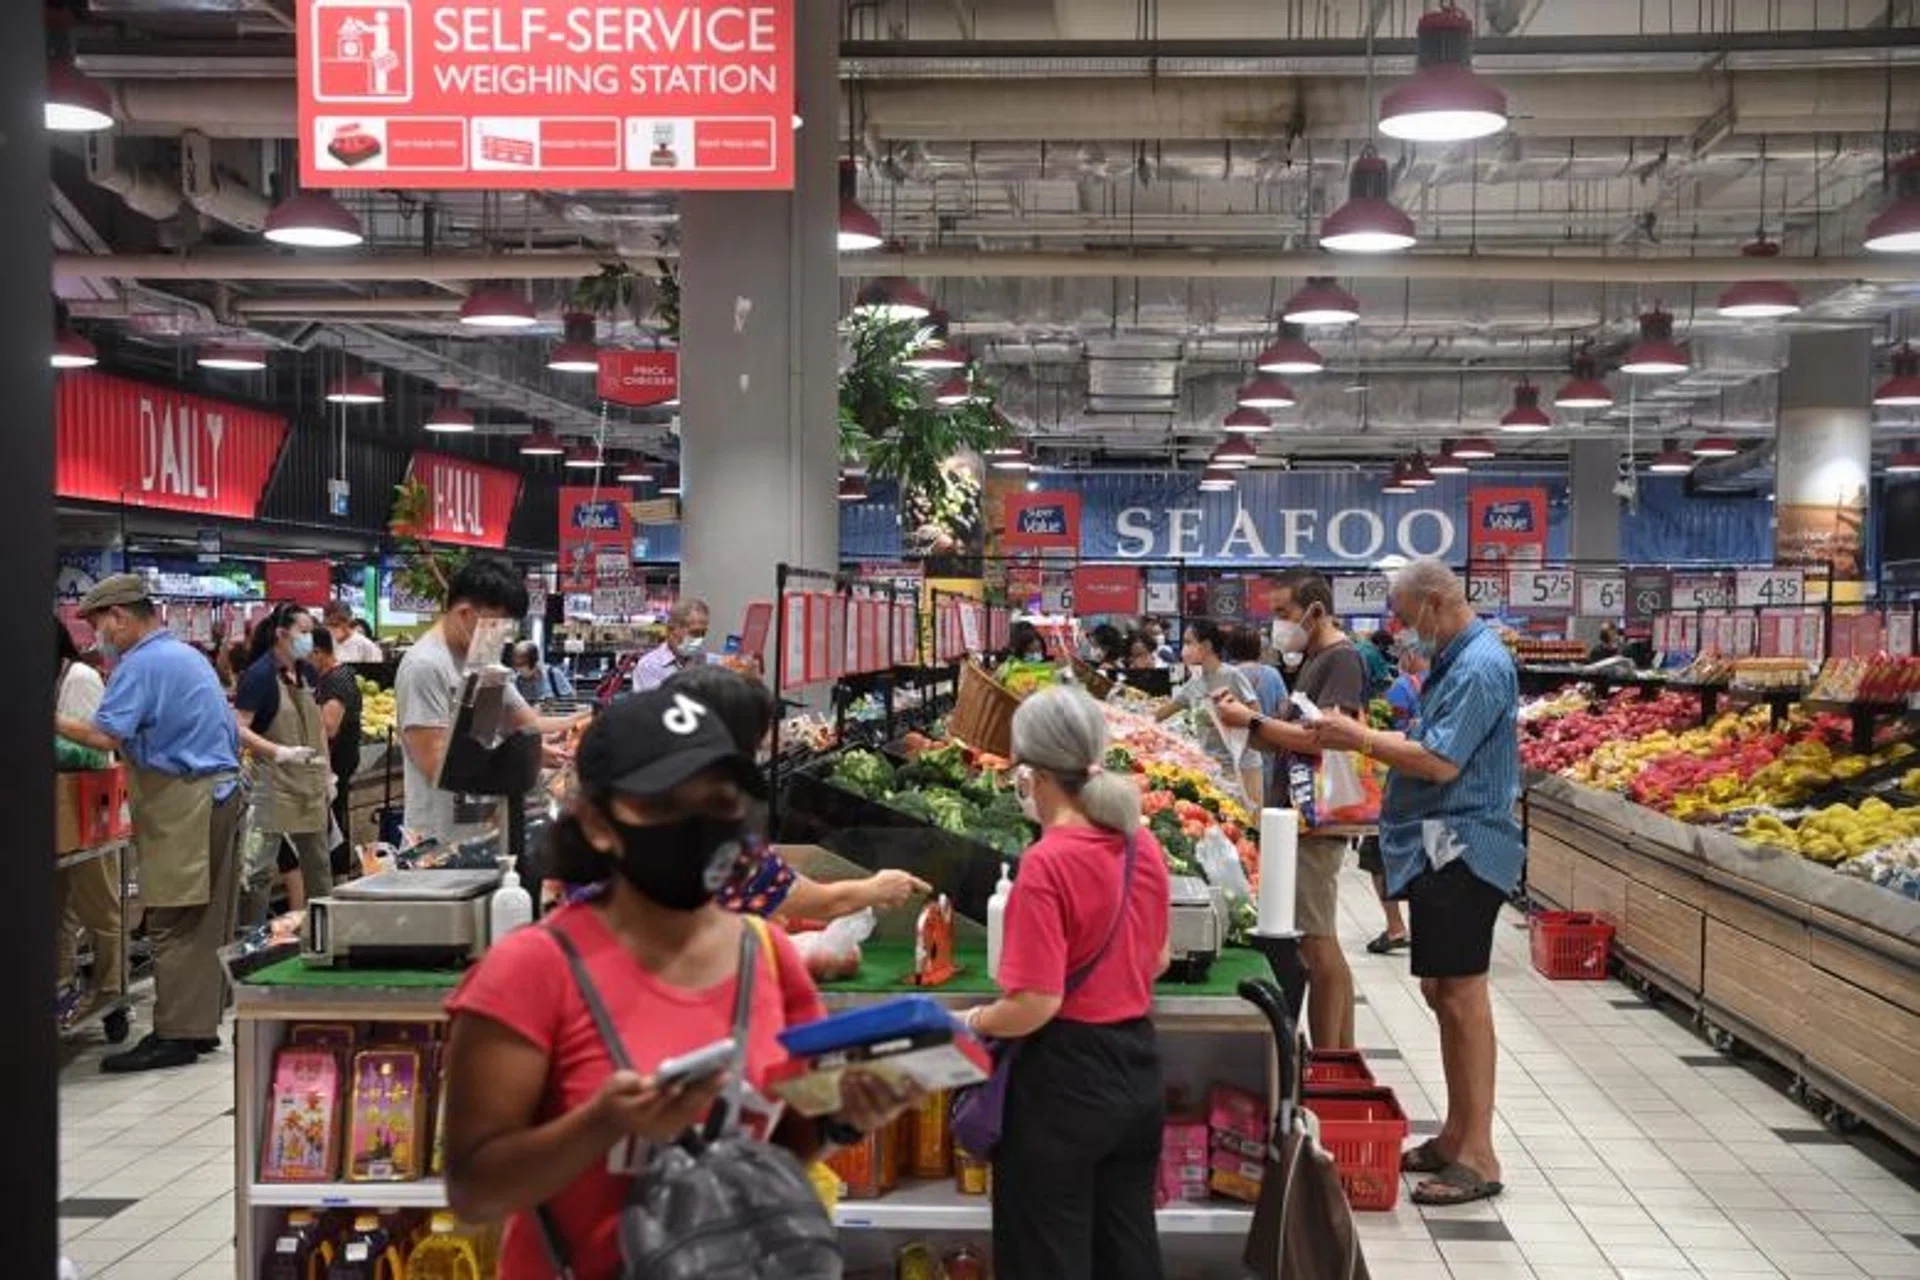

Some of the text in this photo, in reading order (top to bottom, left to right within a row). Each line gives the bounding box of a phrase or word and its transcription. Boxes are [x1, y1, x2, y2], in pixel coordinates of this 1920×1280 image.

[433, 6, 776, 53] SELF-SERVICE
[433, 64, 777, 95] WEIGHING STATION
[140, 397, 224, 500] DAILY
[1022, 516, 1062, 533] Value
[1488, 512, 1529, 530] Value
